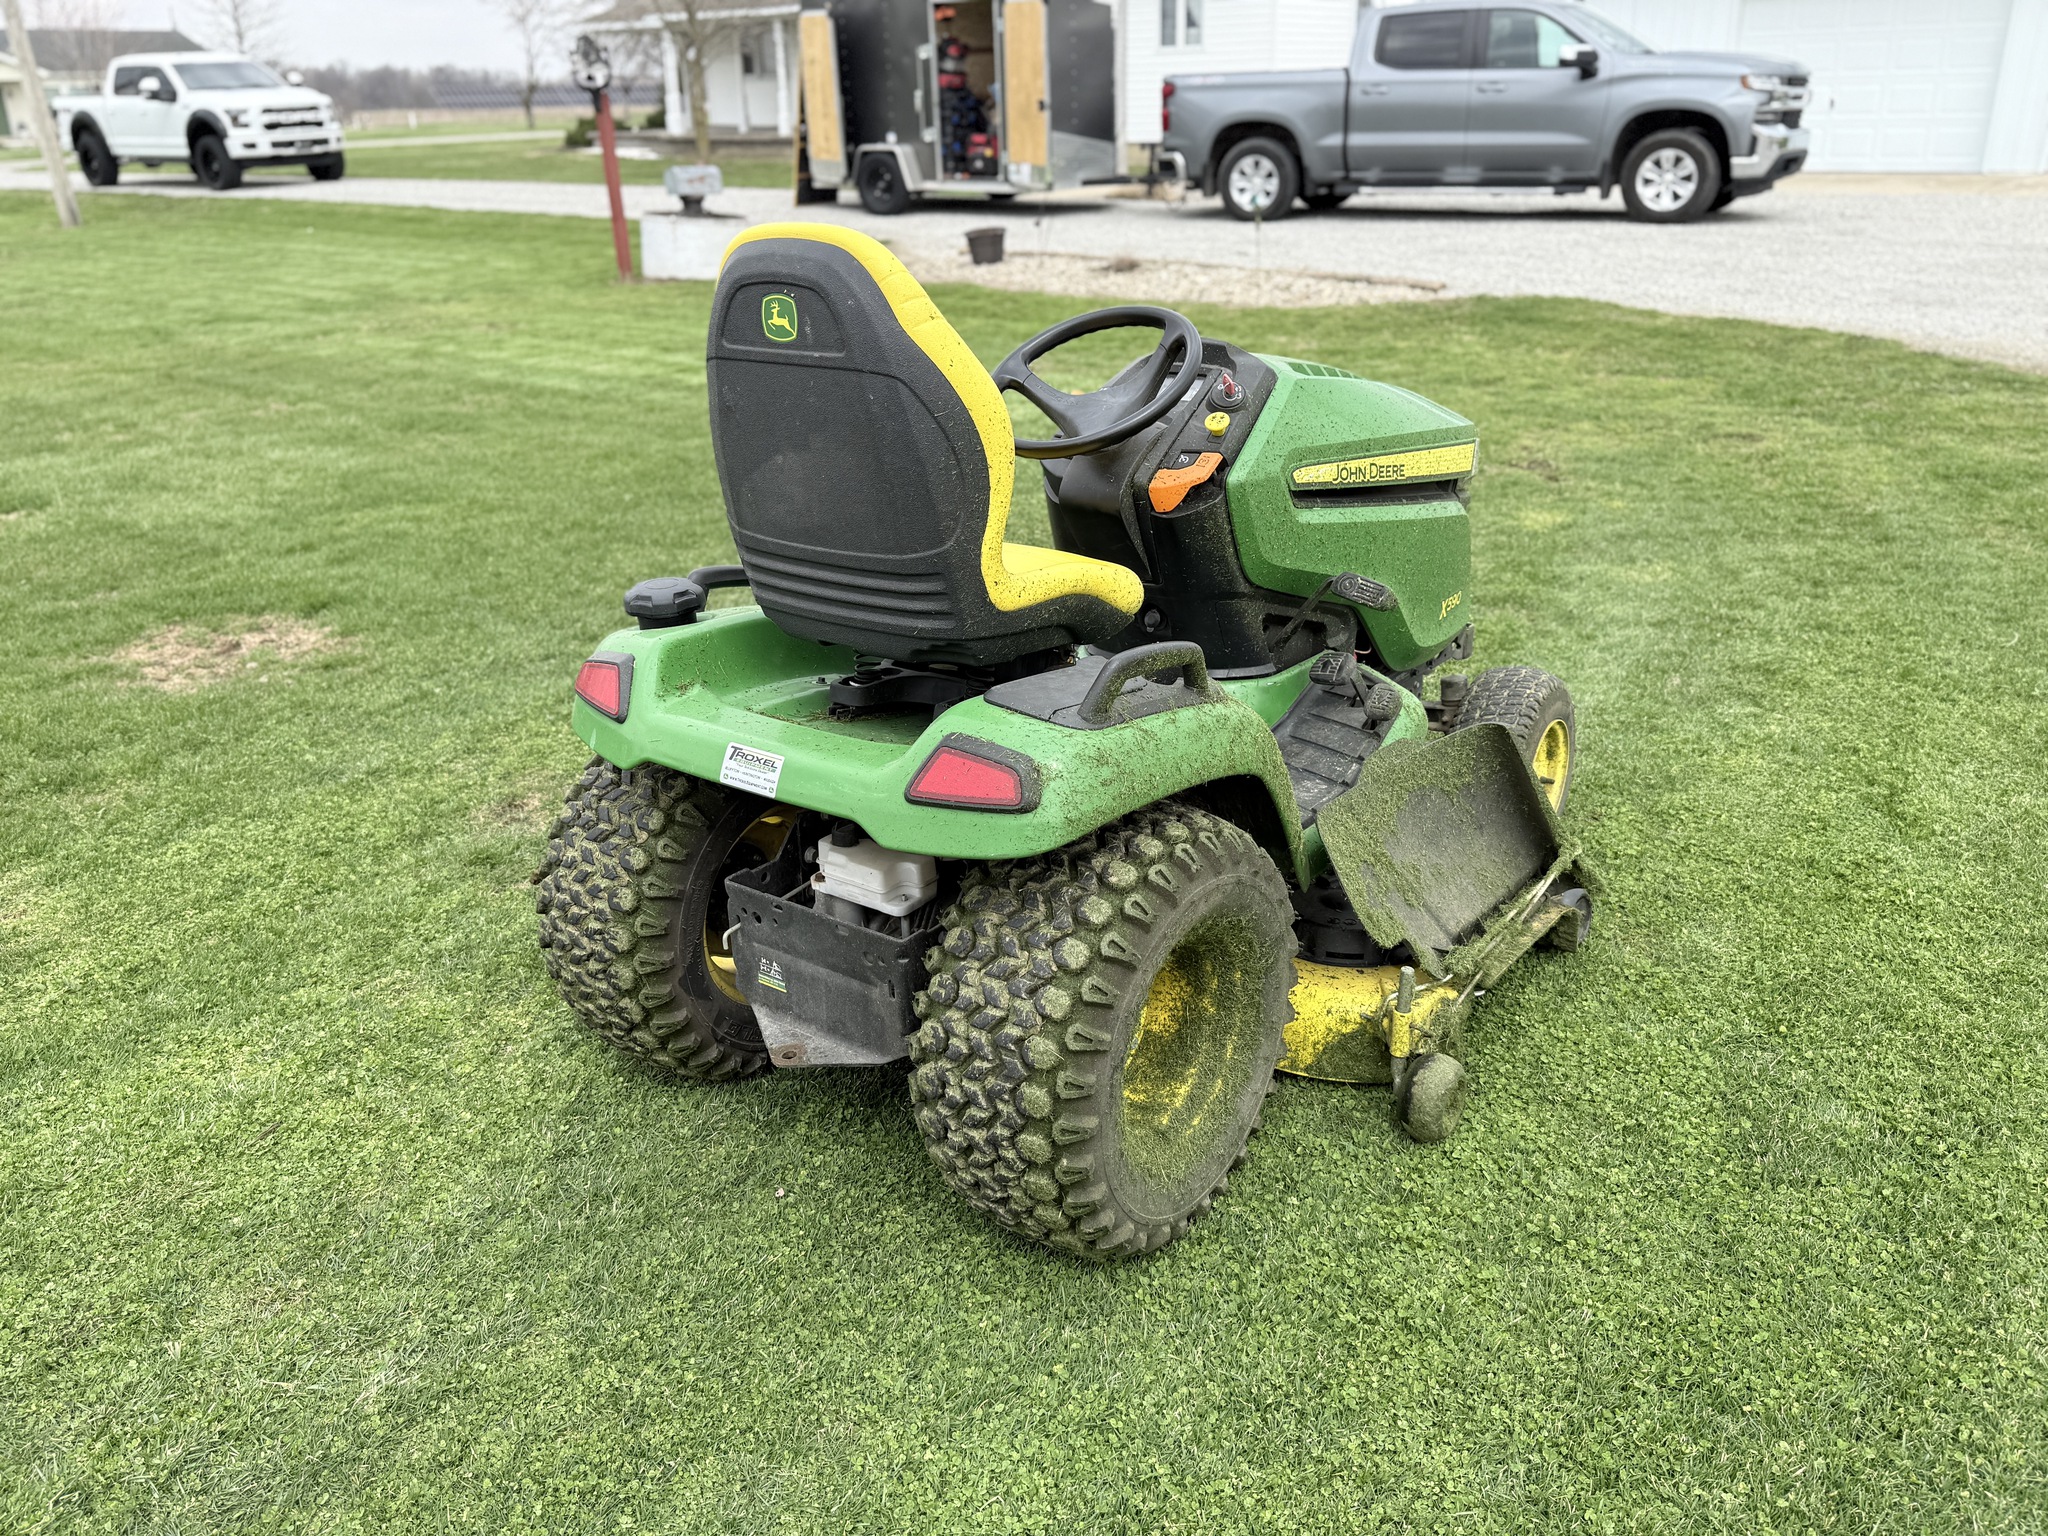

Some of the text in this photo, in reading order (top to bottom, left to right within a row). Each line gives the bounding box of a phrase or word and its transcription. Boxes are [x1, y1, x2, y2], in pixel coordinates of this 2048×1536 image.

[1332, 462, 1405, 482] JOHN DEERE
[1439, 590, 1462, 620] X590
[729, 745, 777, 769] TROXEL
